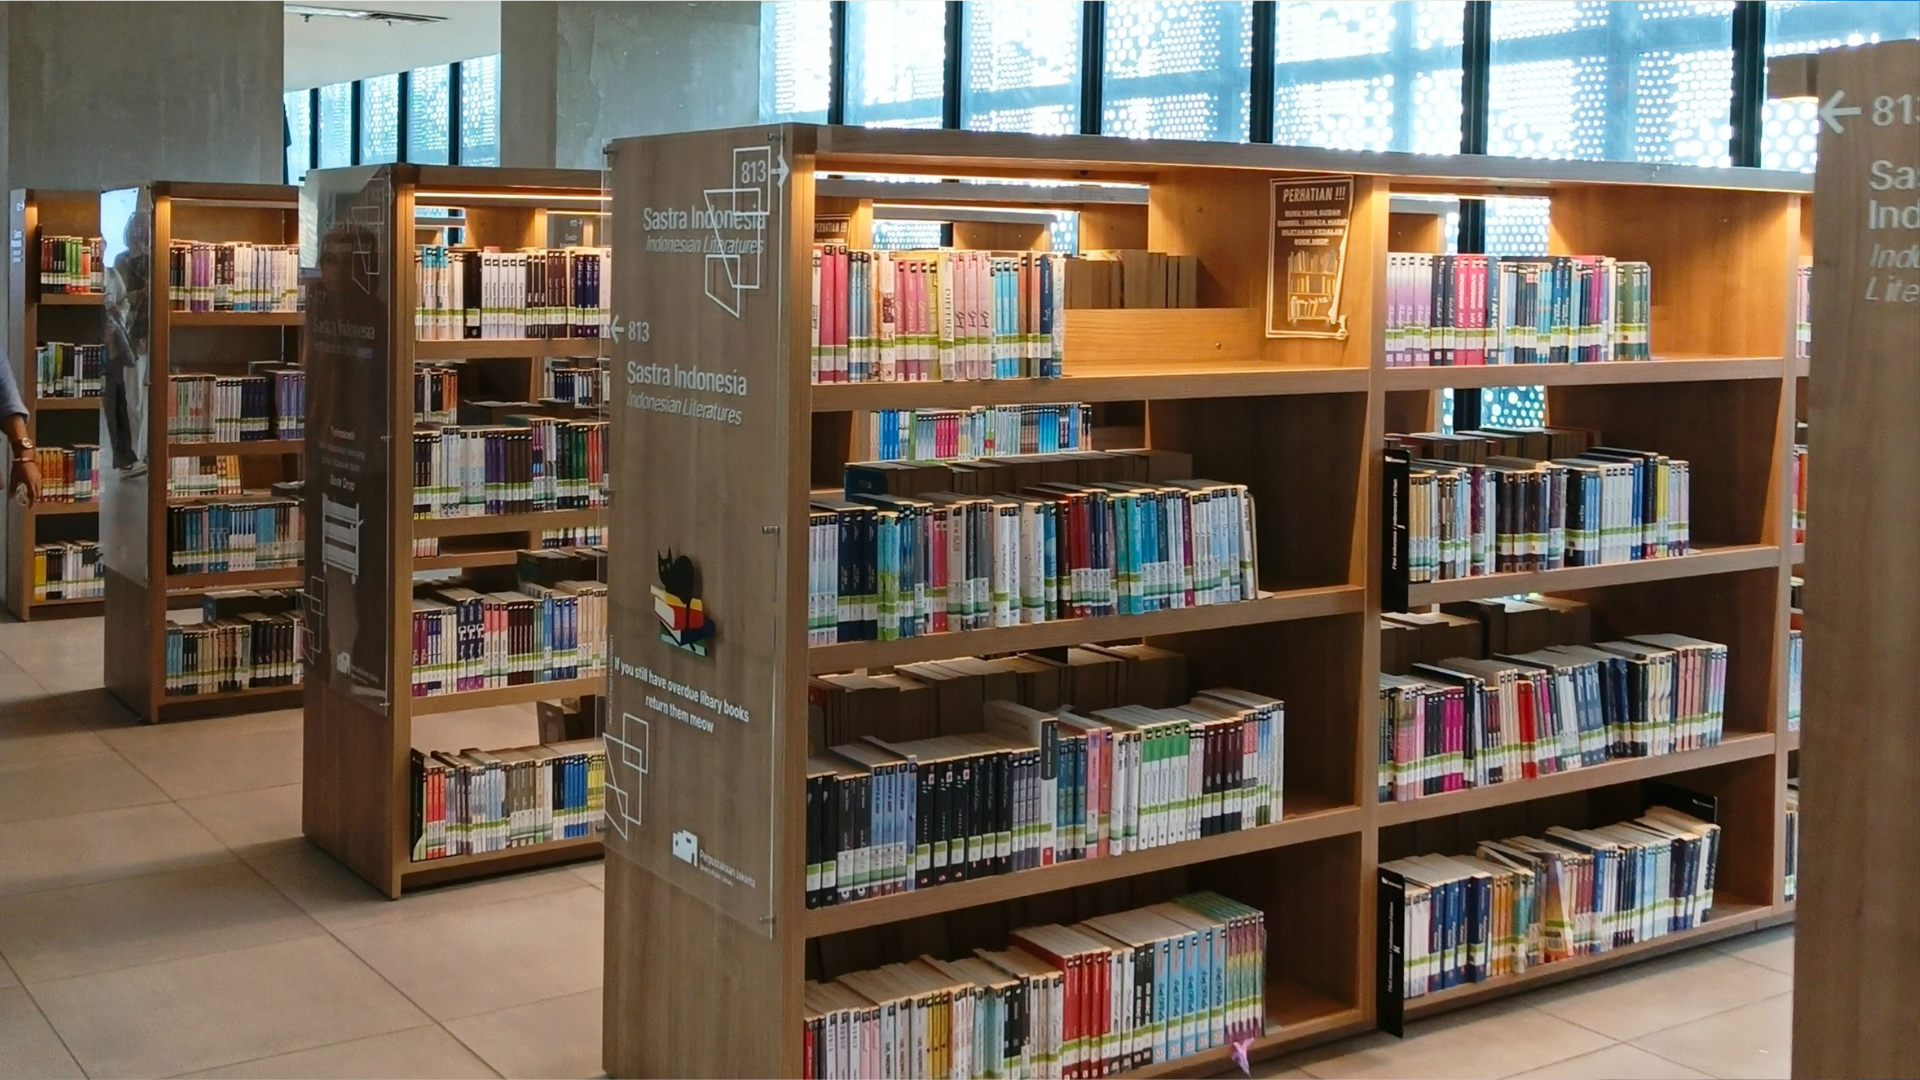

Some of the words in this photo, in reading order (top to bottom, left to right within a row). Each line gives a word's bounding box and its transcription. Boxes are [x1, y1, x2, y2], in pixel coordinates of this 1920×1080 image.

[1872, 94, 1919, 126] 81
[741, 160, 766, 184] 813
[1869, 160, 1919, 191] Sa
[1282, 186, 1333, 202] PERHATIAN
[1335, 186, 1346, 200] !!!
[643, 207, 688, 231] Sastra
[691, 204, 766, 230] Indonesia
[646, 236, 700, 252] Indonesian
[703, 235, 765, 255] Literatures
[628, 321, 650, 342] 813
[627, 361, 671, 387] Sastra
[674, 364, 747, 396] Indonesia
[627, 390, 682, 414] Indonesian
[682, 396, 742, 426] Literatures
[614, 656, 620, 671] If
[621, 662, 634, 676] you
[635, 666, 648, 682] still
[649, 670, 666, 689] have
[667, 680, 699, 702] overdue
[700, 690, 723, 714] libary
[724, 699, 750, 722] books
[645, 695, 668, 715] return
[670, 703, 688, 723] them
[690, 714, 714, 733] meow
[700, 849, 735, 878] Perpustakaan
